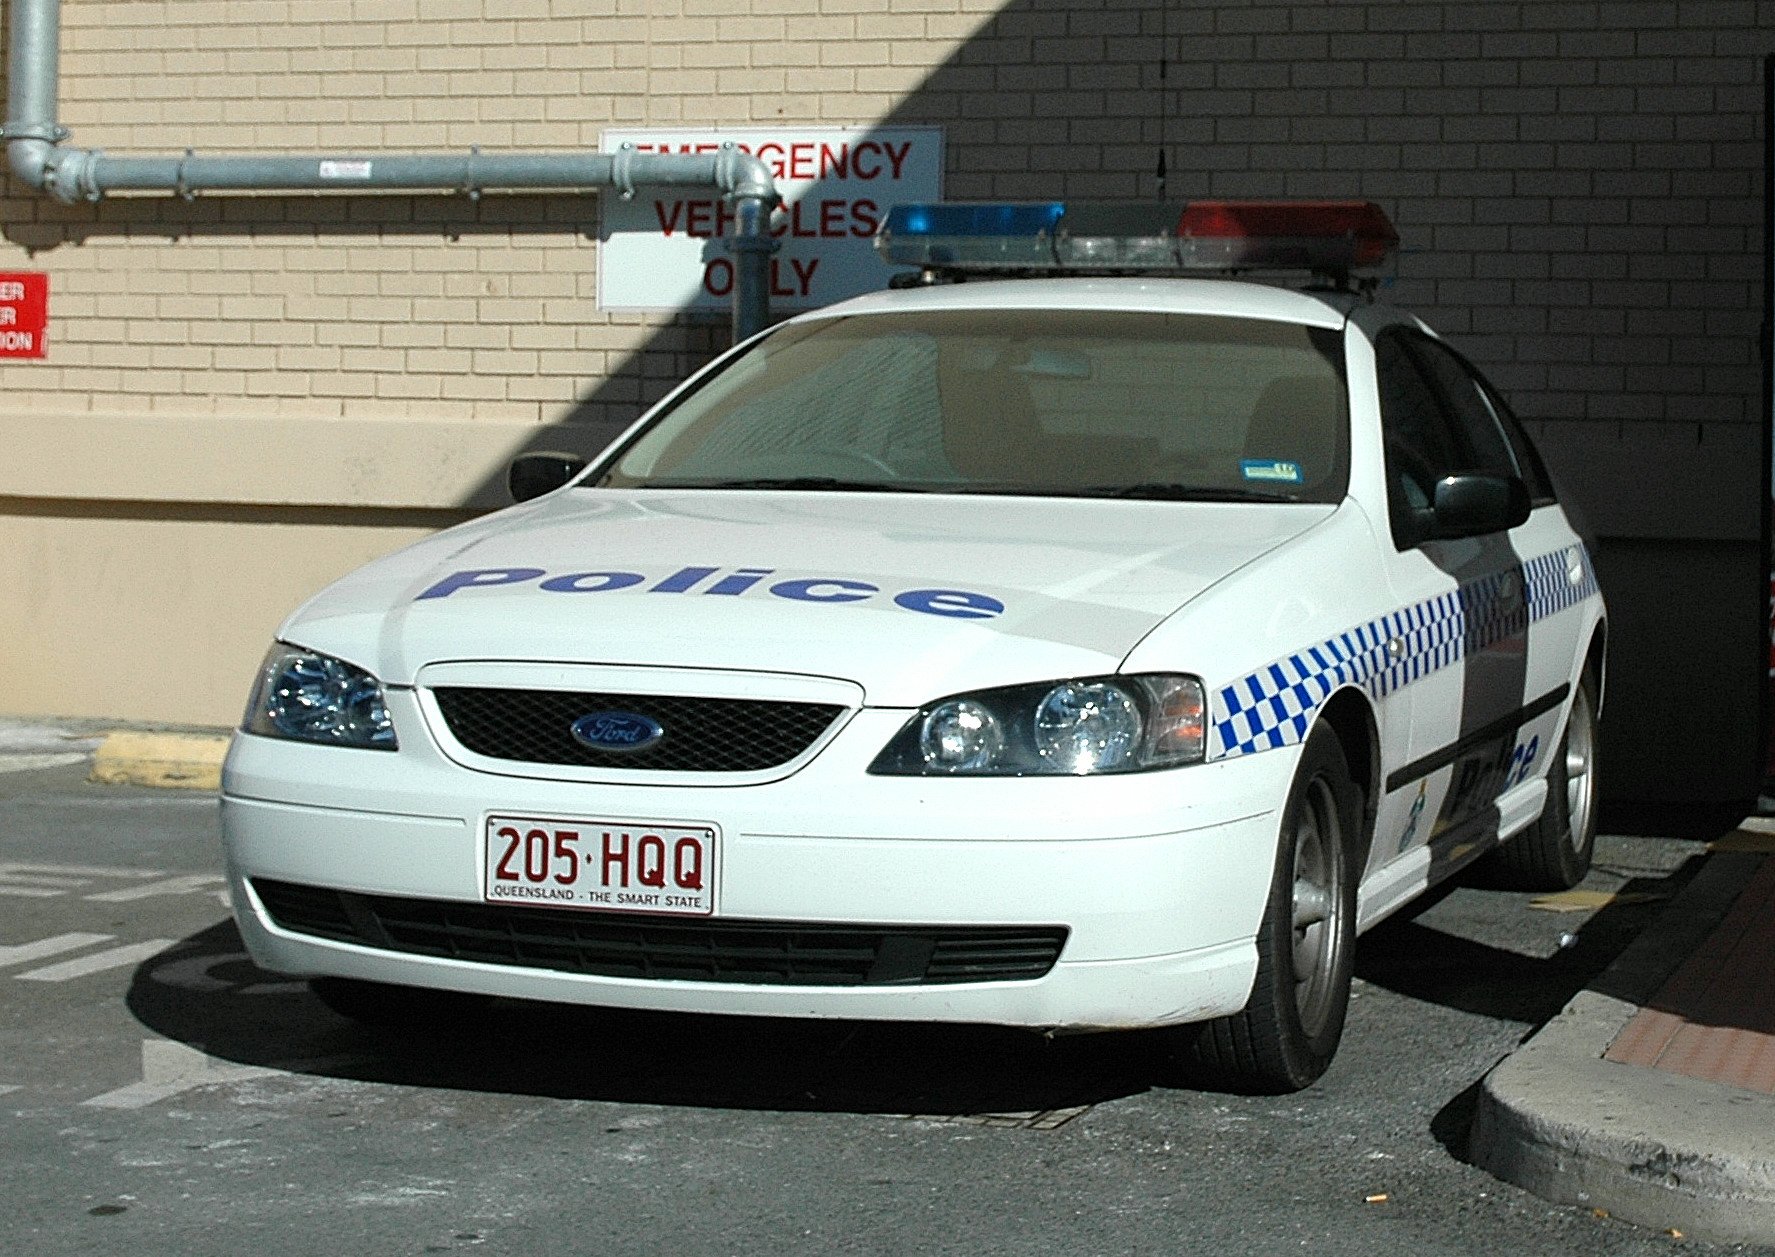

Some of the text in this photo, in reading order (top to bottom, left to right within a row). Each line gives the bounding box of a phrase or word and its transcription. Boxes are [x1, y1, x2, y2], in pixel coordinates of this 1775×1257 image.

[636, 141, 912, 181] GENCY
[654, 199, 879, 239] VEHCLES
[704, 257, 819, 298] OLY
[590, 718, 642, 742] Ford
[493, 883, 575, 901] QUEENSLAND
[588, 891, 612, 903] THE
[617, 893, 660, 906] SMART
[665, 895, 703, 909] STATE
